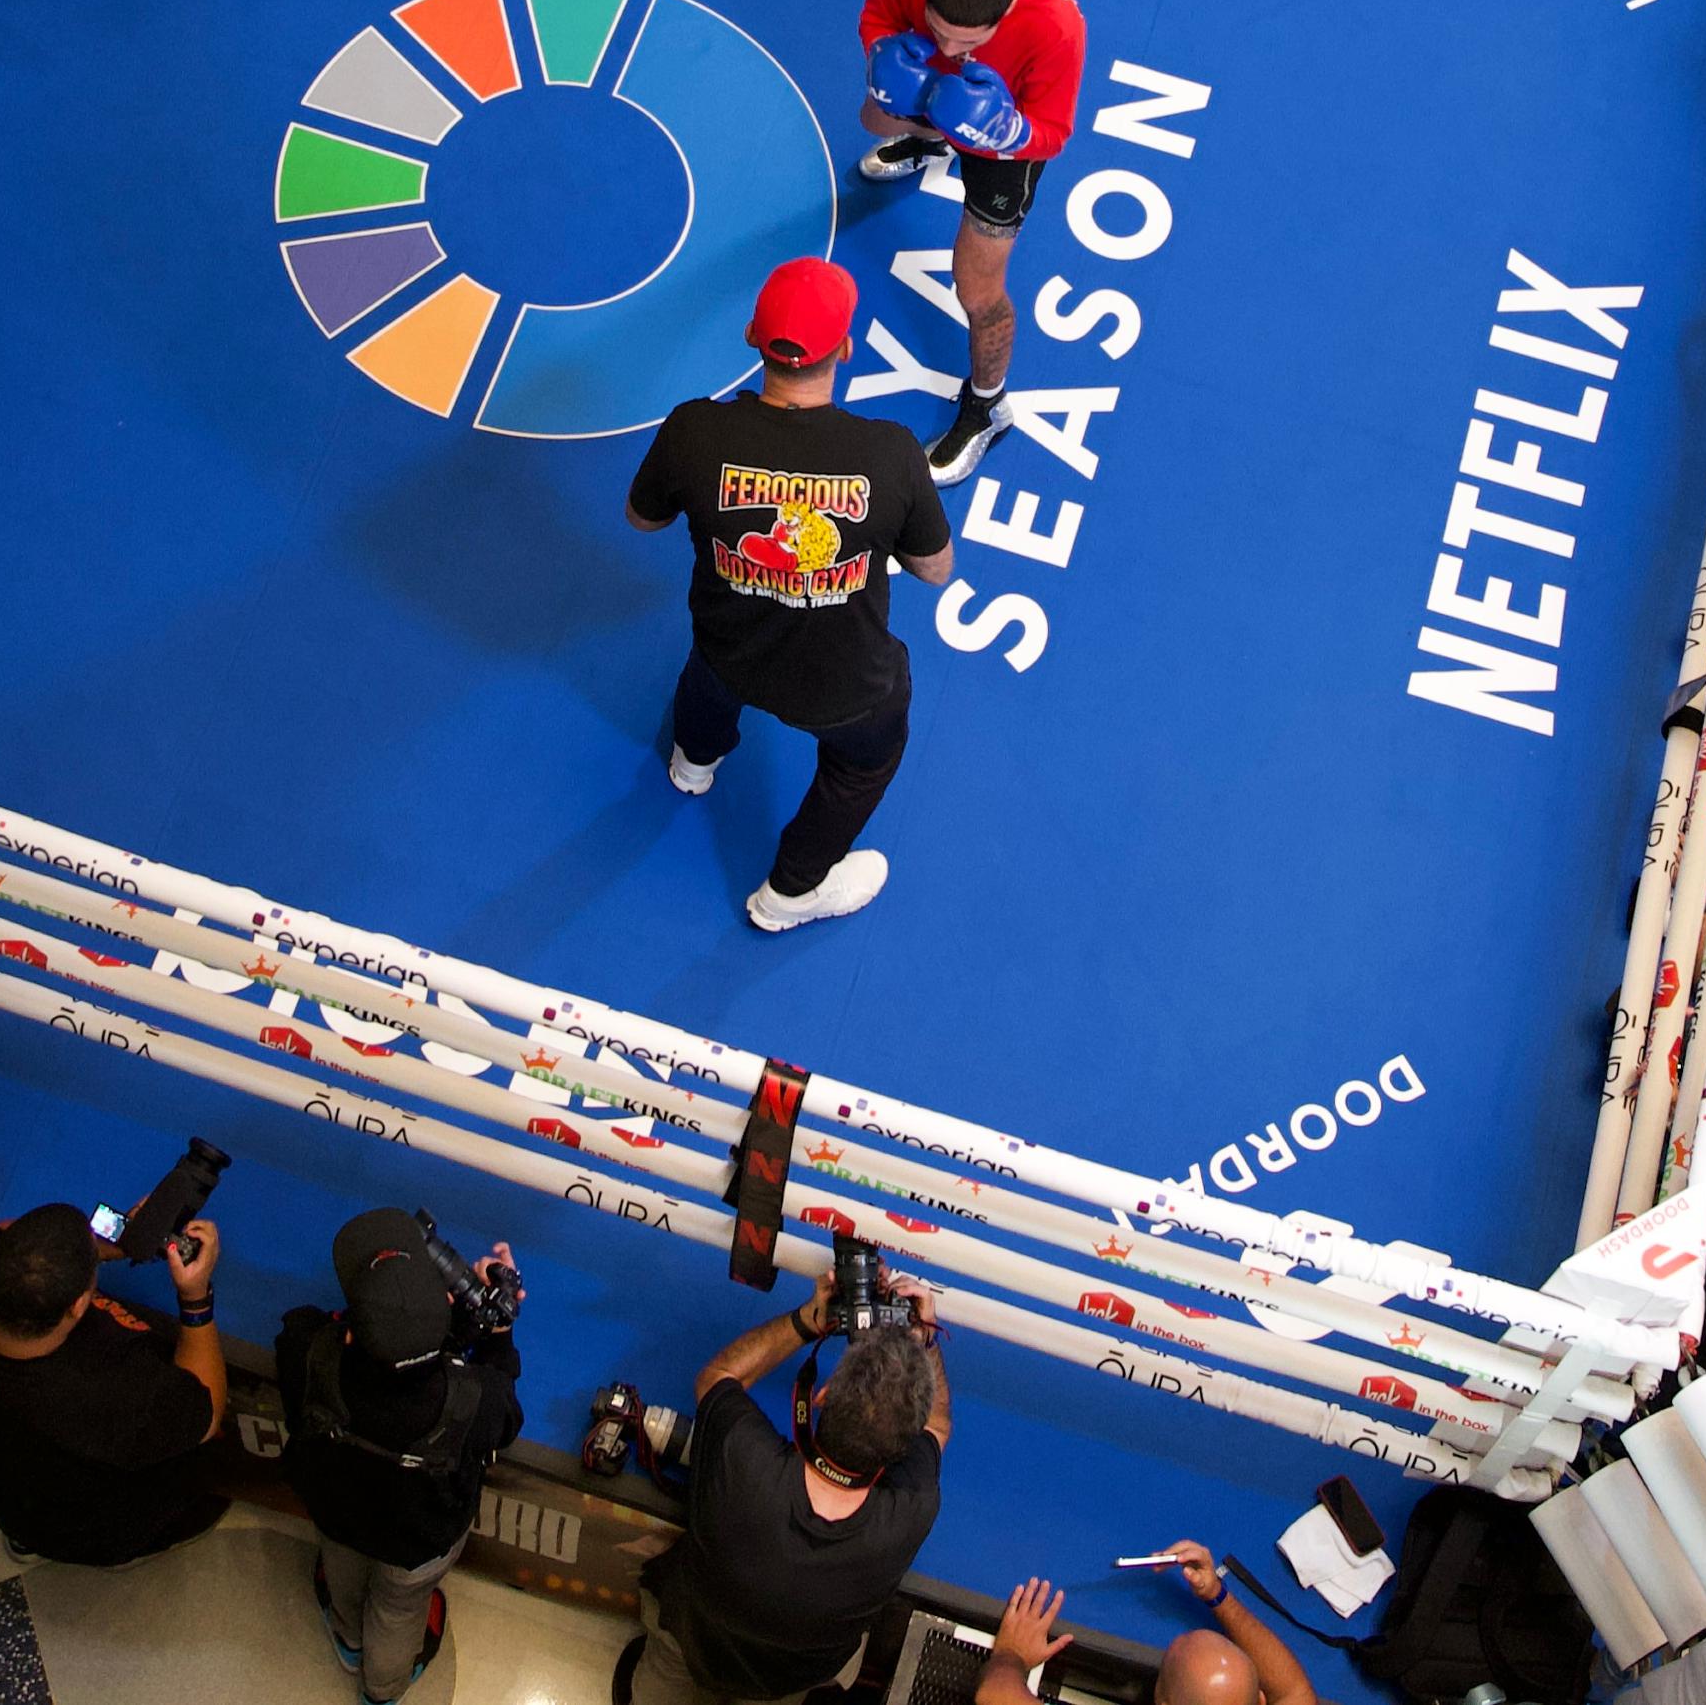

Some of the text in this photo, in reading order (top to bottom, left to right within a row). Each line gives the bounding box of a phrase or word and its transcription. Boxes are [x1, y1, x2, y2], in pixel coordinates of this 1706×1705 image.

[934, 59, 1213, 673] SEASON
[721, 464, 870, 522] FEROCIOUS
[1407, 247, 1645, 737] NETFLIX
[714, 539, 872, 596] BOXING GYM
[730, 582, 754, 596] SAN
[810, 594, 848, 610] TEXAS
[527, 1065, 701, 1134] DRAFTKINGS
[757, 1074, 804, 1128] N
[1595, 1195, 1691, 1260] DOORDASH
[796, 1399, 808, 1426] EOS
[813, 1457, 853, 1486] Canon
